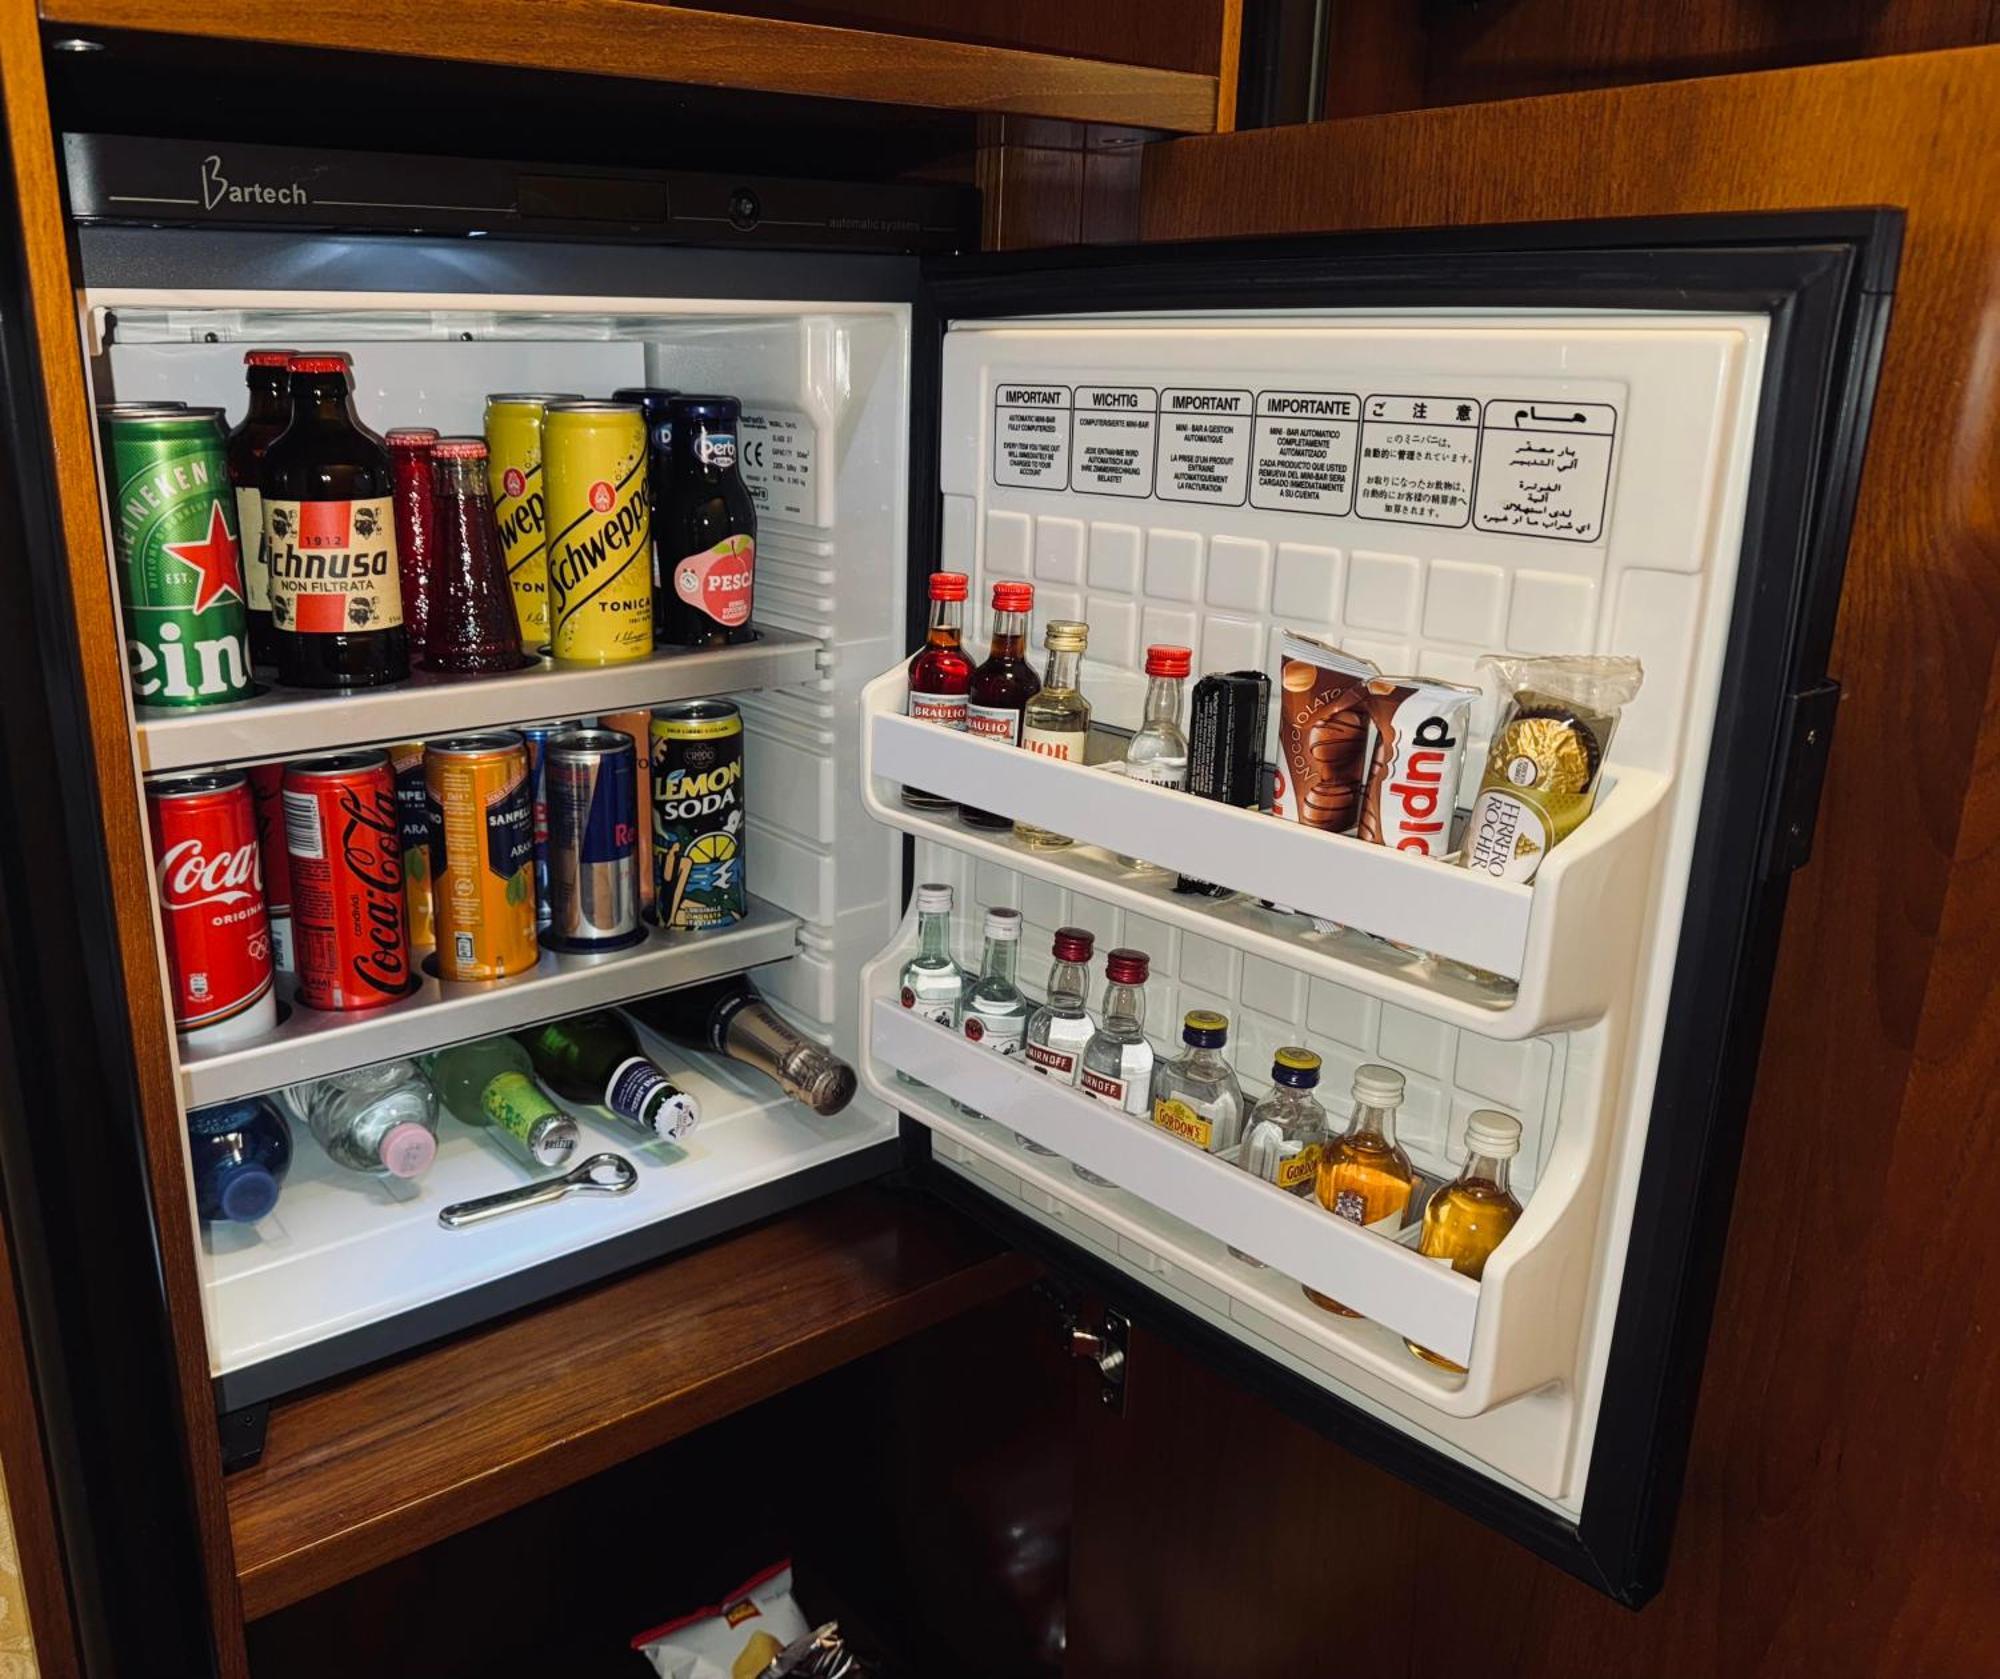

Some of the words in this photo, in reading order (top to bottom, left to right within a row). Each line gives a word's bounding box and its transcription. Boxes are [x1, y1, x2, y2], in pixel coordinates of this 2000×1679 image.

[202, 155, 308, 210] Bartech
[1006, 390, 1062, 404] IMPORTANT
[1092, 393, 1138, 407] WICHTIG
[1172, 396, 1241, 411] IMPORTANT
[1267, 398, 1351, 415] IMPORTANTE
[1184, 434, 1224, 443] AUTOMATIQUE
[1300, 429, 1341, 439] AUTOMATICO
[1277, 437, 1330, 448] COMPLETAMENTE
[1279, 448, 1327, 458] AUTOMATIZADO
[1209, 456, 1234, 465] PRODUIT
[1260, 459, 1276, 467] CADA
[1276, 460, 1311, 470] PRODUCTO
[1312, 462, 1325, 471] QUE
[1326, 463, 1347, 473] USTED
[1173, 472, 1229, 483] AUTOMATIQUEMENT
[1259, 469, 1287, 478] REMUEVA
[1287, 470, 1298, 479] DEL
[1329, 474, 1346, 482] SERA
[1185, 483, 1222, 492] FACTURATION
[1259, 478, 1289, 488] CARGADO
[1285, 489, 1294, 498] SU
[1294, 490, 1320, 500] CUENTA
[118, 461, 208, 564] HEINEKEN
[305, 536, 342, 546] 1912
[165, 573, 192, 585] EST.
[281, 580, 307, 592] NON
[311, 579, 375, 593] FILTRATA
[708, 571, 752, 593] PESC
[128, 622, 252, 696] ein
[914, 705, 966, 719] BRAULIO
[1291, 688, 1342, 781] NOCCIOLATO
[655, 755, 741, 800] LEMON
[664, 787, 735, 820] SODA
[1471, 796, 1503, 869] ROCHER
[1488, 800, 1521, 877] FERRERO
[156, 839, 263, 911] Coca
[337, 782, 407, 995] Coca-Cola
[211, 901, 264, 926] ORIGINA
[1159, 1108, 1201, 1137] GORDON'S
